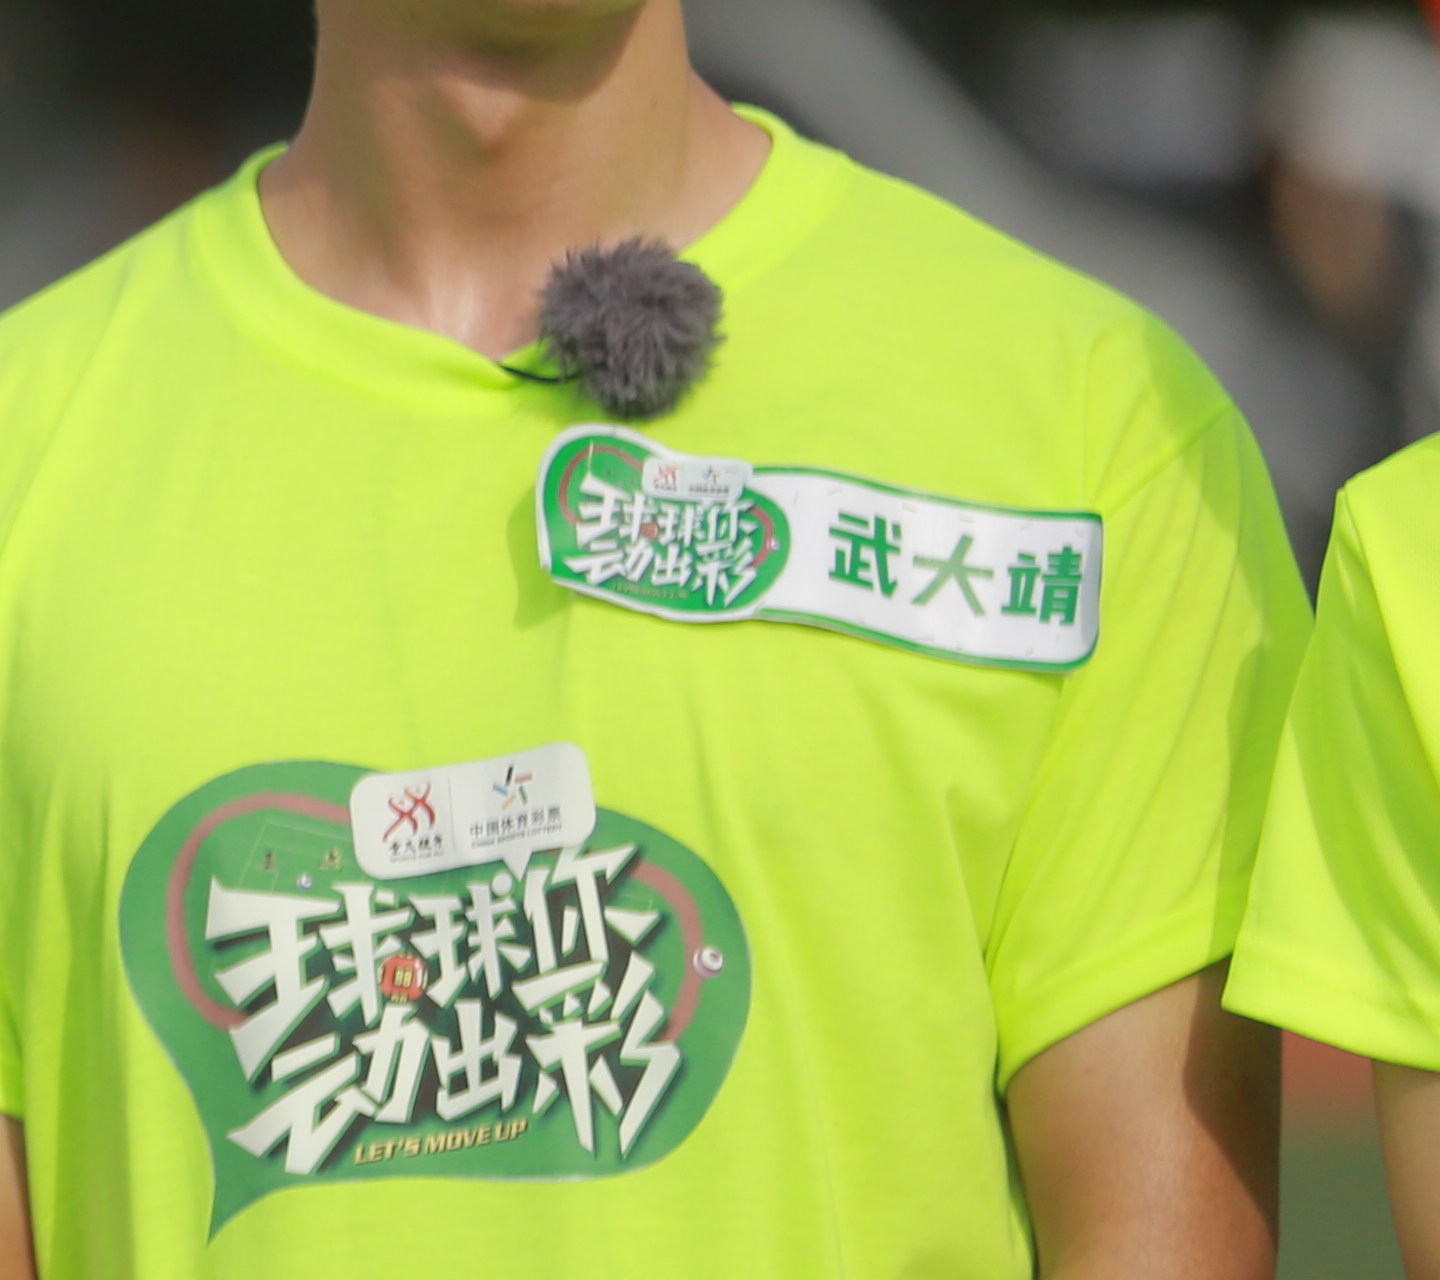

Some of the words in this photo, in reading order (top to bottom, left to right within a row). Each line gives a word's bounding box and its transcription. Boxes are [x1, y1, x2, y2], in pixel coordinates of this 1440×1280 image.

[576, 471, 759, 550] 球球你
[563, 536, 759, 609] 动出彩
[828, 510, 1084, 626] 武大靖
[205, 843, 661, 1084] 球球你
[226, 951, 683, 1176] 动出彩
[354, 1133, 421, 1166] LET'S
[425, 1123, 491, 1155] MOVE
[495, 1116, 528, 1143] UP
